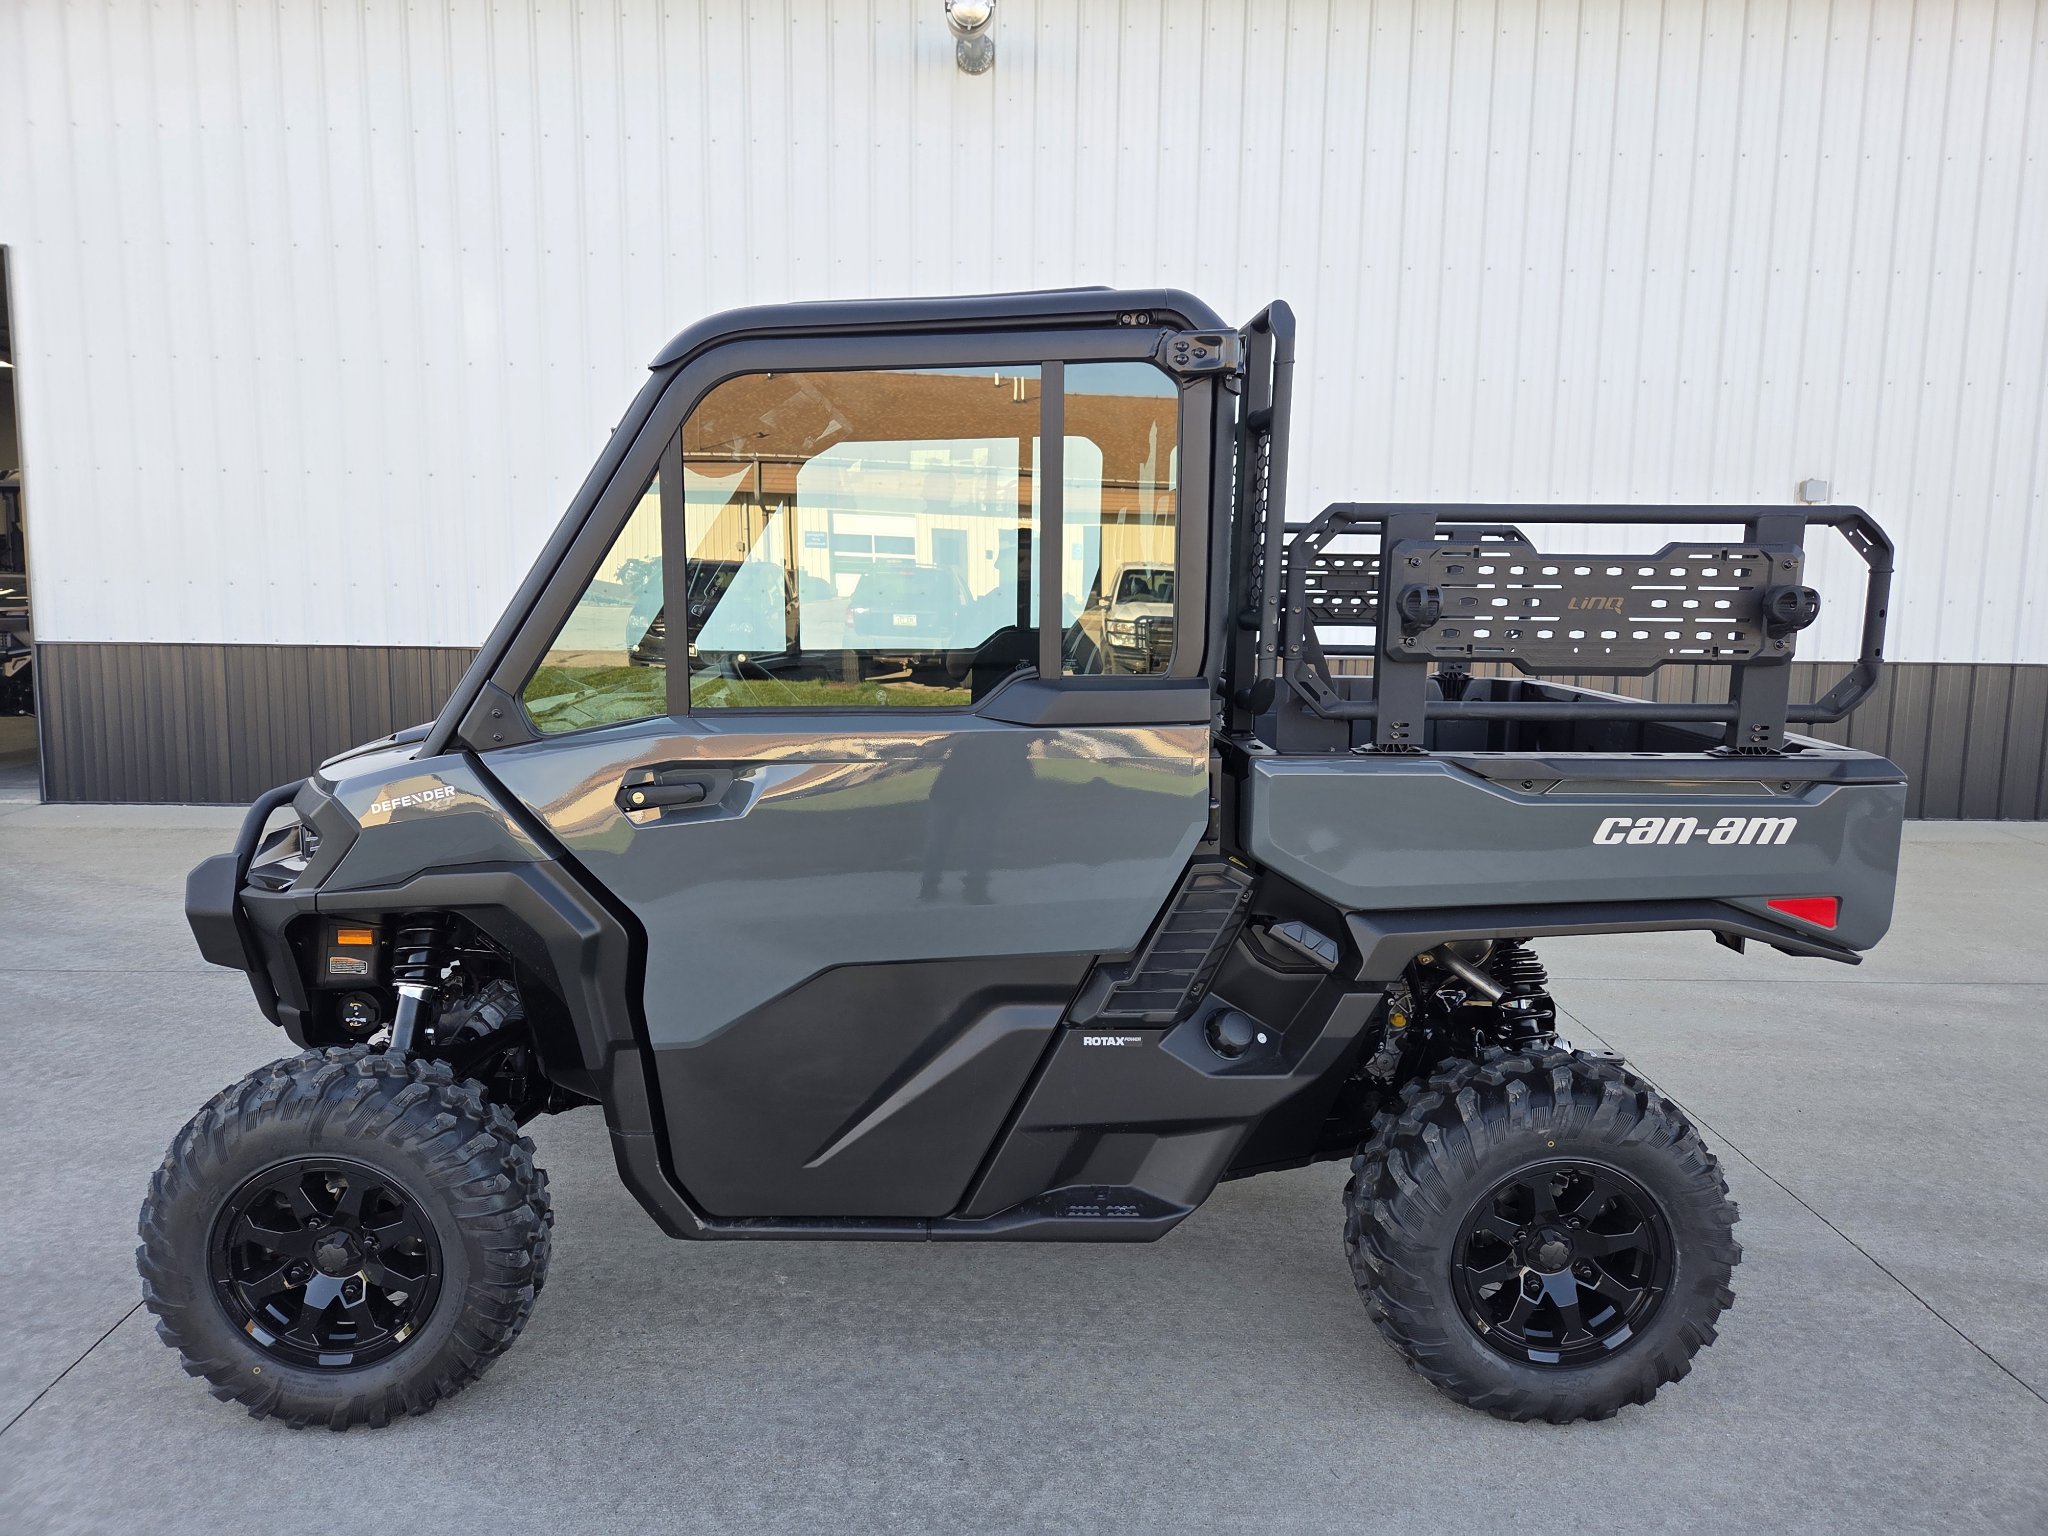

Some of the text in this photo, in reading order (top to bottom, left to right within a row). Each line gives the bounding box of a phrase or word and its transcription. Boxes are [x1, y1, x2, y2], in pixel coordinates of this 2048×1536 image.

[370, 785, 456, 815] DEFENDER
[1592, 816, 1798, 845] can-am
[1083, 1036, 1125, 1046] ROTAX
